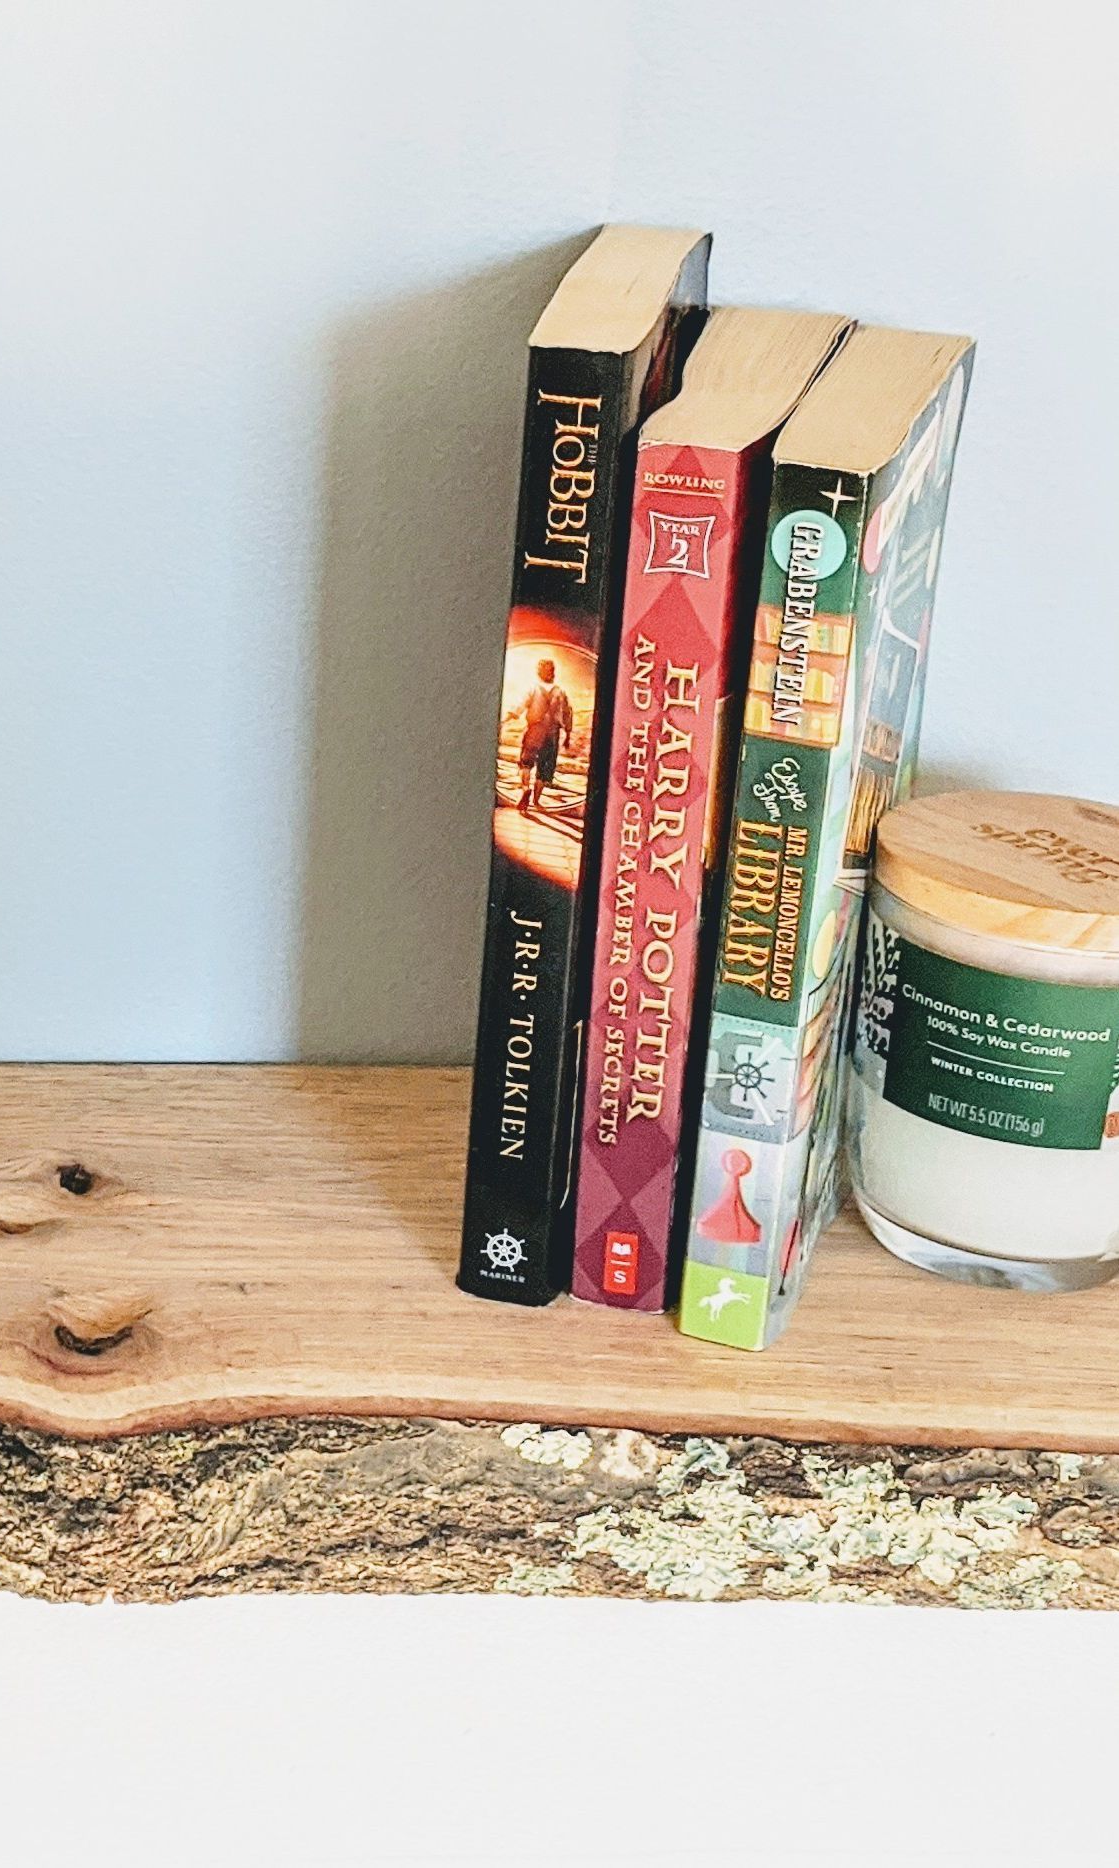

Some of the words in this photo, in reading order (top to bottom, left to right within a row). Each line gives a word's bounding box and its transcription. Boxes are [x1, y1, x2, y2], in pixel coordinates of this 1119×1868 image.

[523, 388, 602, 584] HOBBIT
[643, 472, 726, 490] ROWLING
[659, 520, 701, 537] YEAR
[666, 532, 689, 570] 2
[770, 520, 825, 726] GRABENSTEIN
[630, 633, 657, 711] AND
[624, 721, 652, 793] THE
[648, 659, 701, 890] HARRY
[785, 825, 809, 861] MR.
[609, 801, 642, 966] CHAMBER
[721, 818, 784, 998] LIBRARY
[769, 864, 805, 1001] LEMONCELLO'S
[608, 976, 629, 1020] OF
[625, 906, 679, 1124] POTTER
[901, 982, 981, 1025] Cinnamon
[985, 1013, 999, 1030] &
[1003, 1017, 1111, 1043] Cedarwood
[926, 1015, 959, 1036] 100%
[961, 1026, 985, 1045] Soy
[986, 1033, 1017, 1051] Wax
[1019, 1041, 1072, 1059] Candle
[931, 1056, 974, 1077] WINTER
[976, 1070, 1054, 1093] COLLECTION
[499, 1013, 535, 1160] TOLKIEN
[598, 1025, 626, 1145] SECRETS
[928, 1092, 949, 1112] NET
[949, 1097, 969, 1116] WT
[969, 1104, 987, 1125] 5.5
[988, 1109, 1004, 1129] OZ
[1004, 1111, 1031, 1135] (156
